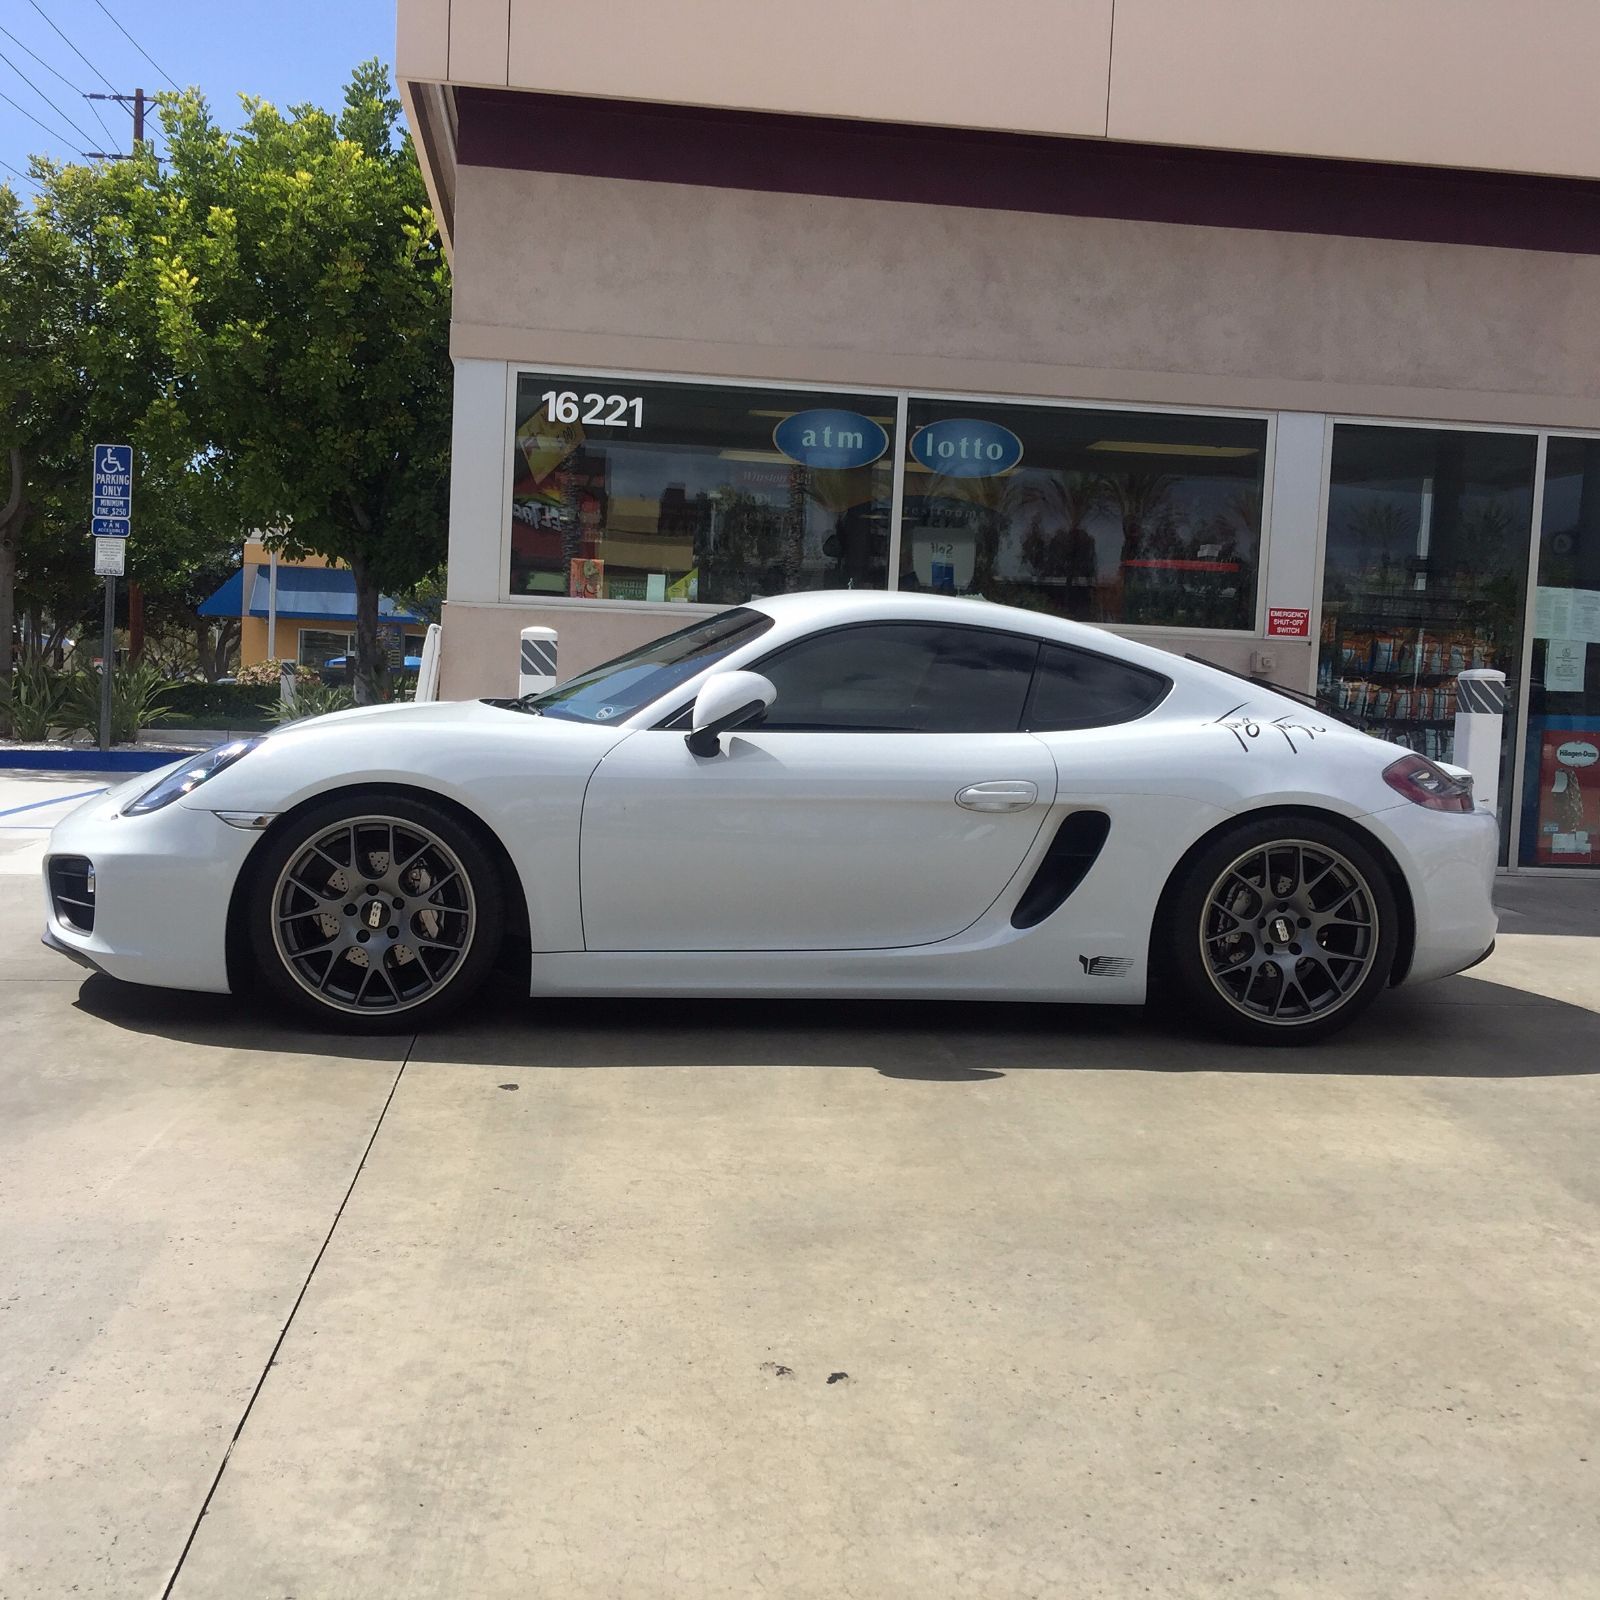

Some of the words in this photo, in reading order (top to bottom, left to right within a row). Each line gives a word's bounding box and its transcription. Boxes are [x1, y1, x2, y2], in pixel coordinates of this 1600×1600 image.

[541, 390, 643, 428] 16221
[801, 425, 863, 449] atm
[926, 432, 1004, 461] lotto
[96, 474, 130, 486] PARKING
[102, 485, 123, 496] ONLY
[100, 498, 124, 507] MINIMUM
[97, 507, 109, 515] FINE
[111, 507, 127, 516] $250
[102, 521, 120, 529] VAN
[1270, 610, 1308, 618] EMERGENCY
[1273, 618, 1304, 626] SHUT-OFF
[1276, 626, 1300, 634] SWITCH
